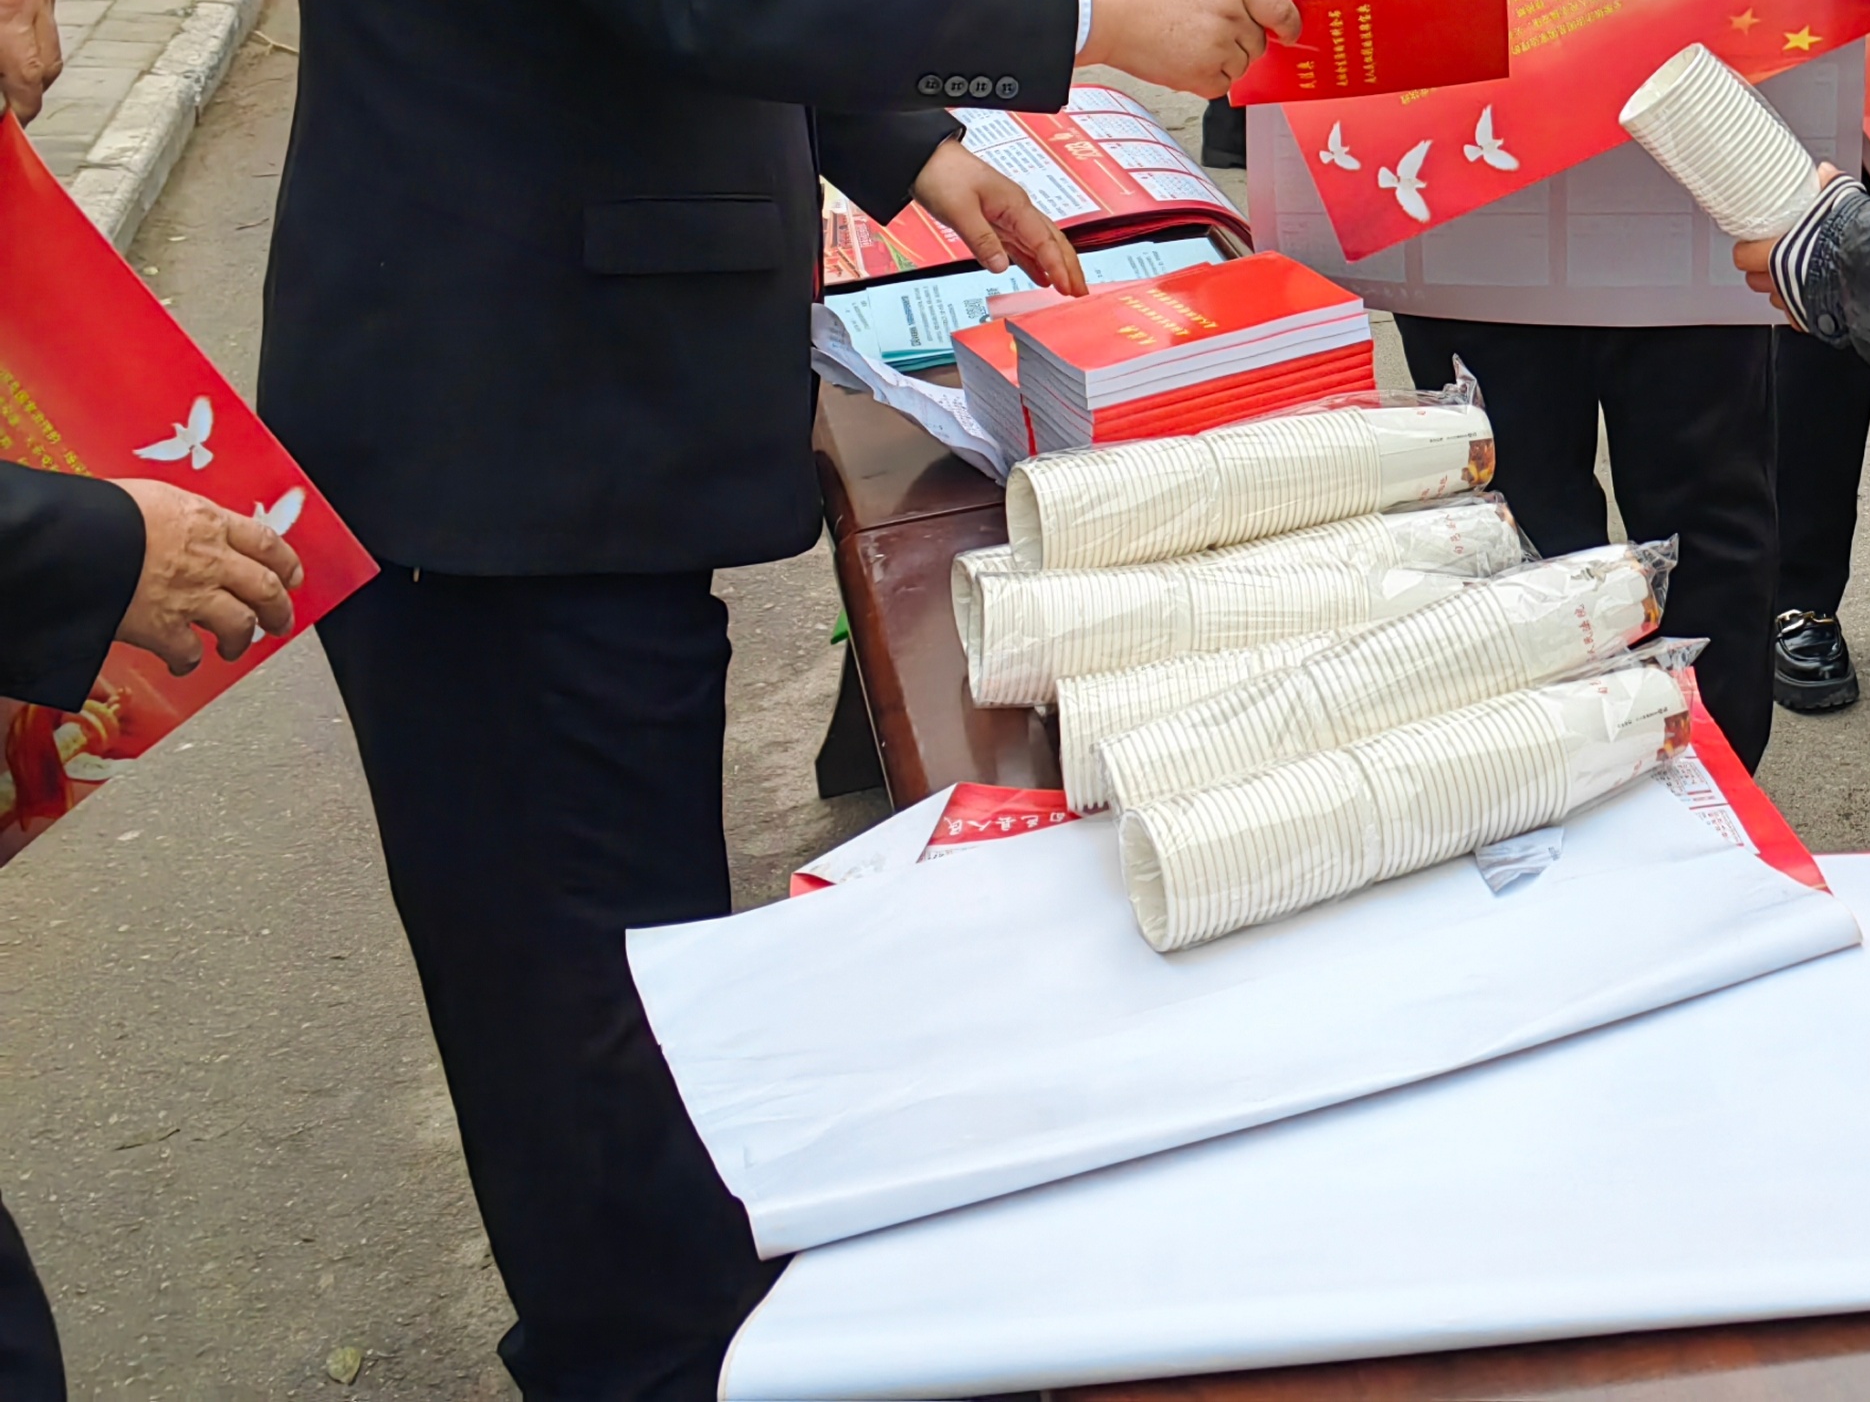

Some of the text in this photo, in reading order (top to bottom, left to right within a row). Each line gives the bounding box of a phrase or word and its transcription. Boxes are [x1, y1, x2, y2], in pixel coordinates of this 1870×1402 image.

[945, 811, 1066, 836] 旬邑县人民
